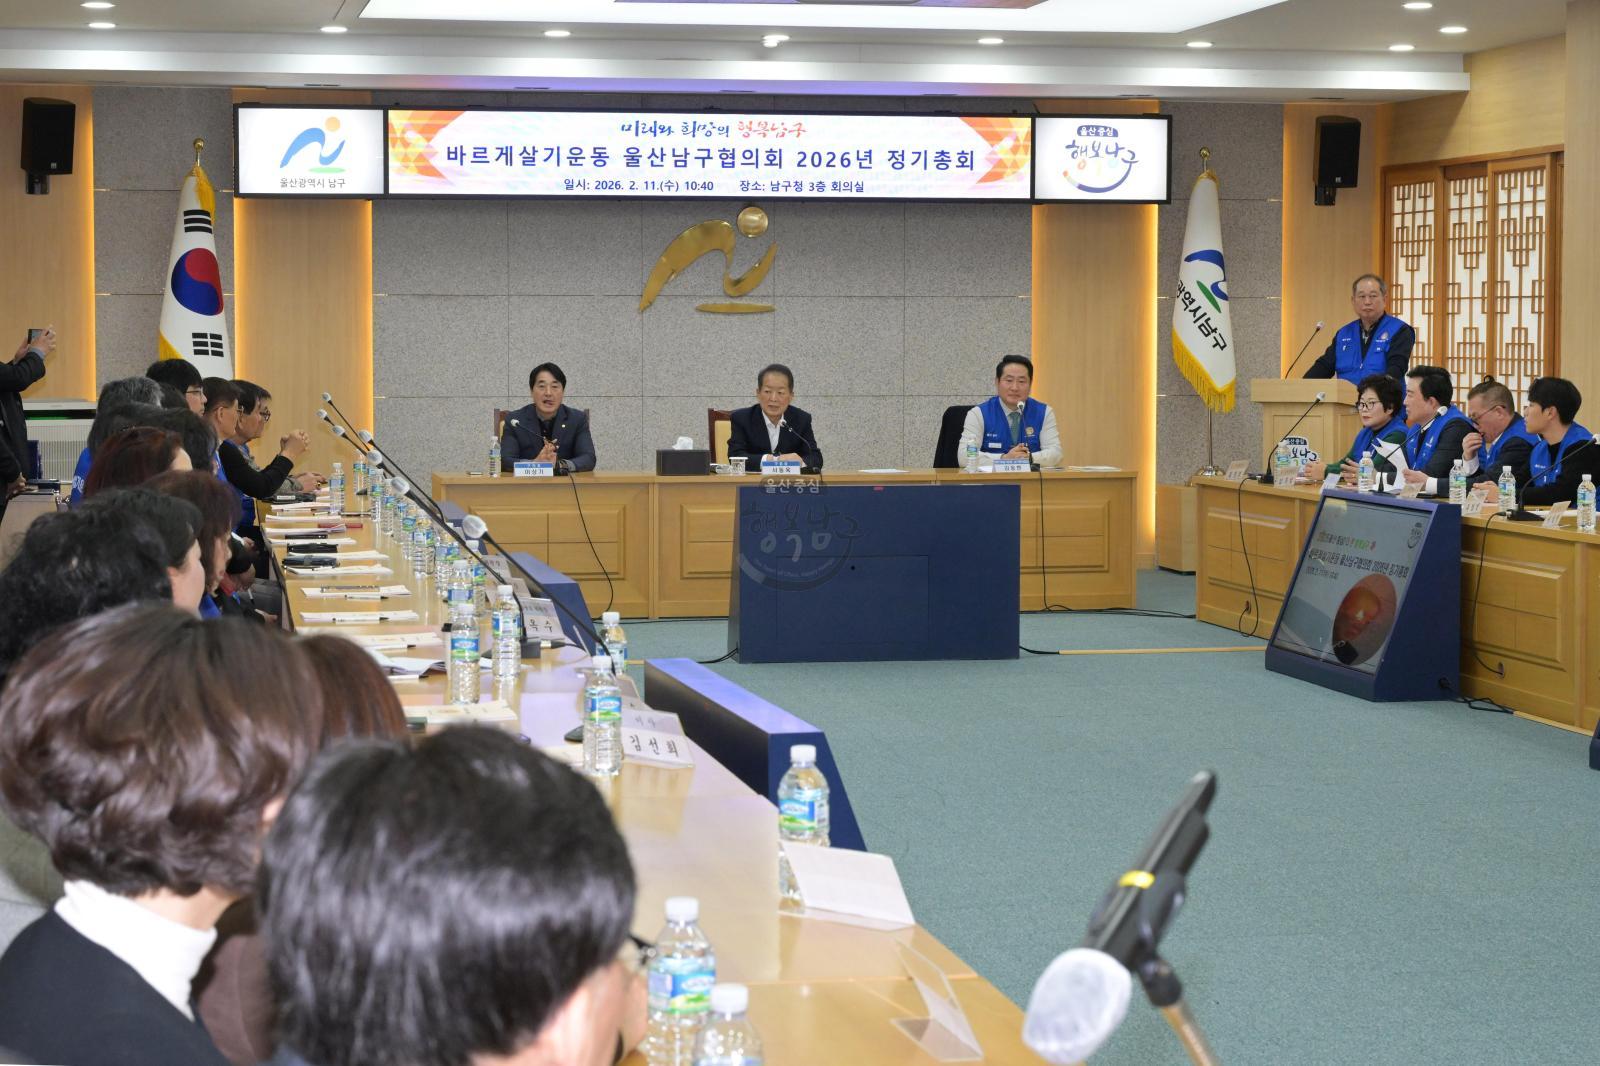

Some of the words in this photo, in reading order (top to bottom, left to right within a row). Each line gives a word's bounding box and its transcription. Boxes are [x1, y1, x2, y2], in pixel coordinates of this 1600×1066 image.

[621, 120, 674, 137] 미래와
[681, 120, 729, 138] 희망의
[737, 120, 807, 138] 행복남구
[447, 146, 610, 168] 바르게살기운동
[623, 147, 782, 169] 울산남구협의회
[796, 149, 873, 170] 2026년
[887, 149, 974, 171] 정기총회
[279, 177, 326, 189] 울산광역시
[328, 178, 346, 189] 남구
[563, 179, 590, 192] 일시:
[594, 181, 625, 191] 2026.
[629, 181, 639, 191] 2.
[643, 180, 680, 193] 11.(수)
[684, 181, 714, 192] 10:40
[739, 180, 766, 193] 장소:
[769, 180, 804, 193] 남구청
[808, 181, 828, 193] 3층
[831, 181, 865, 193] 회의실
